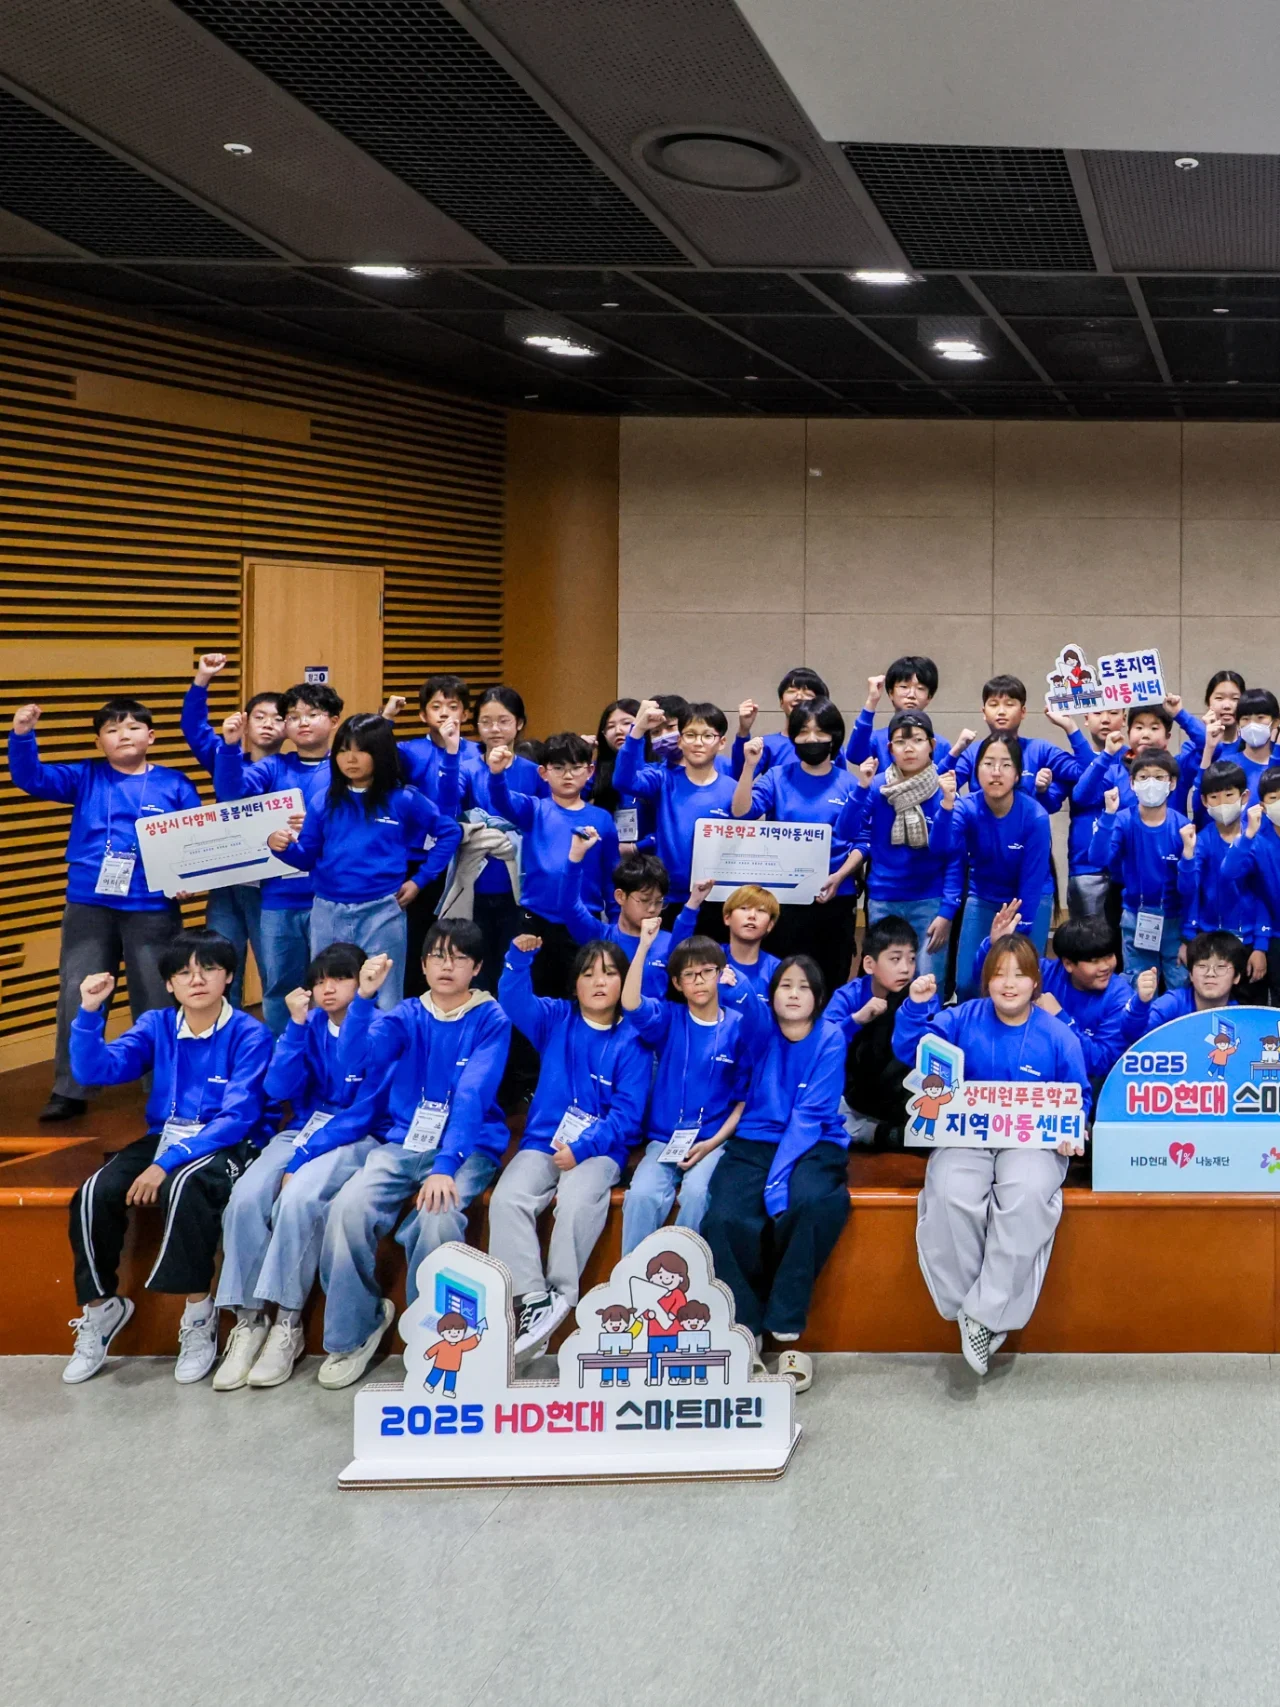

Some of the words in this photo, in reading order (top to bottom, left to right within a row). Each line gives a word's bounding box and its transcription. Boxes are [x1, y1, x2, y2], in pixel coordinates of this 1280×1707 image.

[1101, 654, 1157, 679] 도촌지역
[1104, 679, 1162, 704] 아동센터
[144, 818, 180, 836] 성남시
[182, 811, 217, 827] 다함께
[219, 802, 264, 822] 돌봄센터
[265, 795, 294, 811] 1호점
[702, 824, 756, 839] 즐거운학교
[759, 826, 824, 842] 지역아동센터
[1124, 1054, 1185, 1074] 2025
[963, 1086, 1078, 1109] 상대원푸른학교
[1128, 1083, 1226, 1114] HD현대
[945, 1113, 1080, 1143] 지역아동센터
[1130, 1156, 1168, 1167] HD현대
[1195, 1156, 1230, 1167] 나눔재단
[380, 1403, 484, 1436] 2025
[494, 1400, 604, 1434] HD현대
[615, 1396, 763, 1430] 스마트마린
